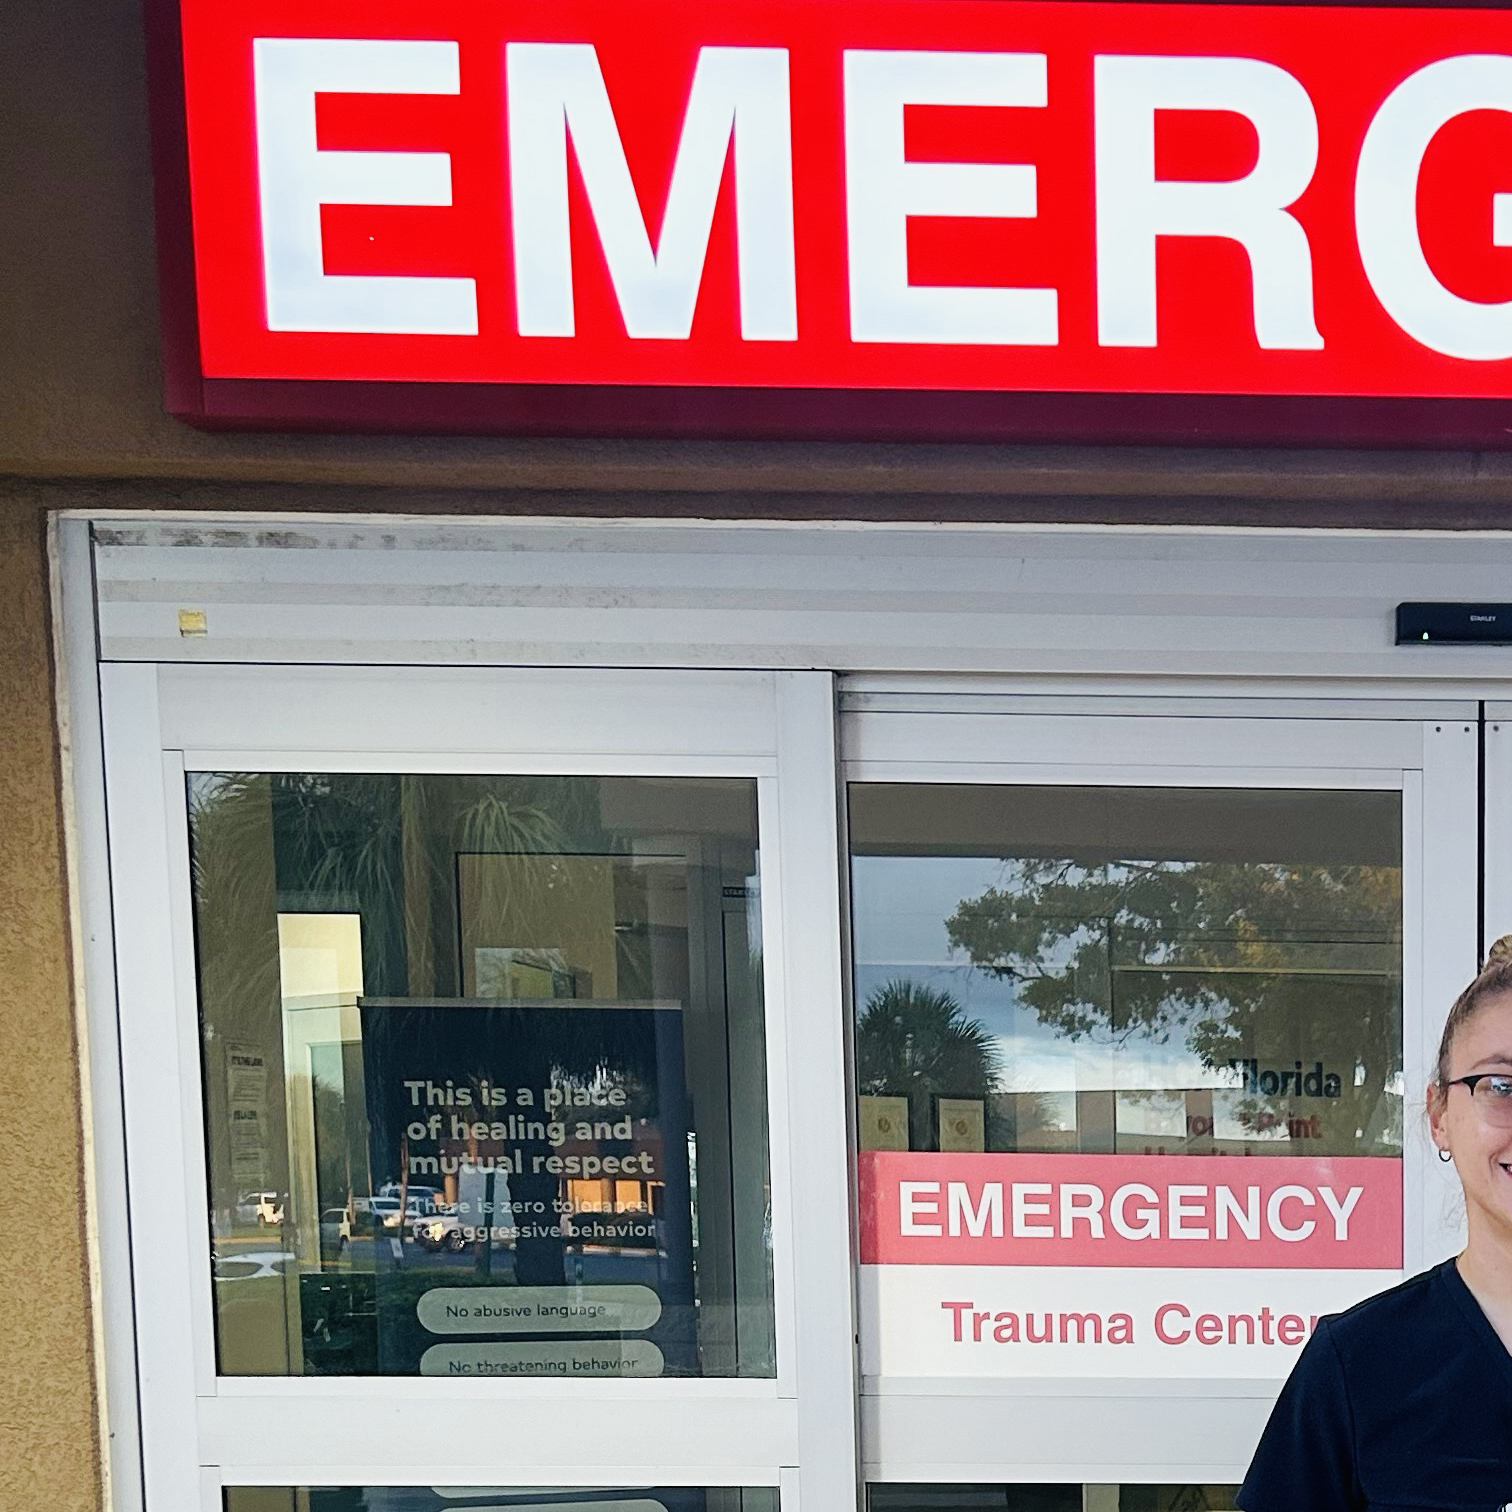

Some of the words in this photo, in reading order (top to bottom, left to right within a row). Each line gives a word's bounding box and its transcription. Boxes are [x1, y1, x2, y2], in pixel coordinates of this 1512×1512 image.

[404, 1080, 472, 1106] This
[481, 1080, 507, 1106] is
[516, 1087, 533, 1106] a
[544, 1081, 626, 1113] place
[407, 1114, 442, 1140] of
[452, 1114, 566, 1146] healing
[575, 1114, 632, 1140] and
[410, 1149, 522, 1174] mutual
[533, 1151, 655, 1180] respect
[412, 1199, 470, 1213] There
[477, 1197, 495, 1213] is
[501, 1201, 545, 1213] zero
[552, 1197, 647, 1213] tolerance
[899, 1181, 1365, 1242] EMERGENCY
[450, 1222, 561, 1242] aggressive
[568, 1220, 655, 1238] behavior
[446, 1305, 468, 1317] No
[473, 1304, 532, 1317] abusive
[537, 1303, 606, 1319] language
[941, 1301, 1135, 1345] Trauma
[449, 1361, 472, 1373] No
[477, 1359, 566, 1373] threatening
[572, 1357, 639, 1371] behavior
